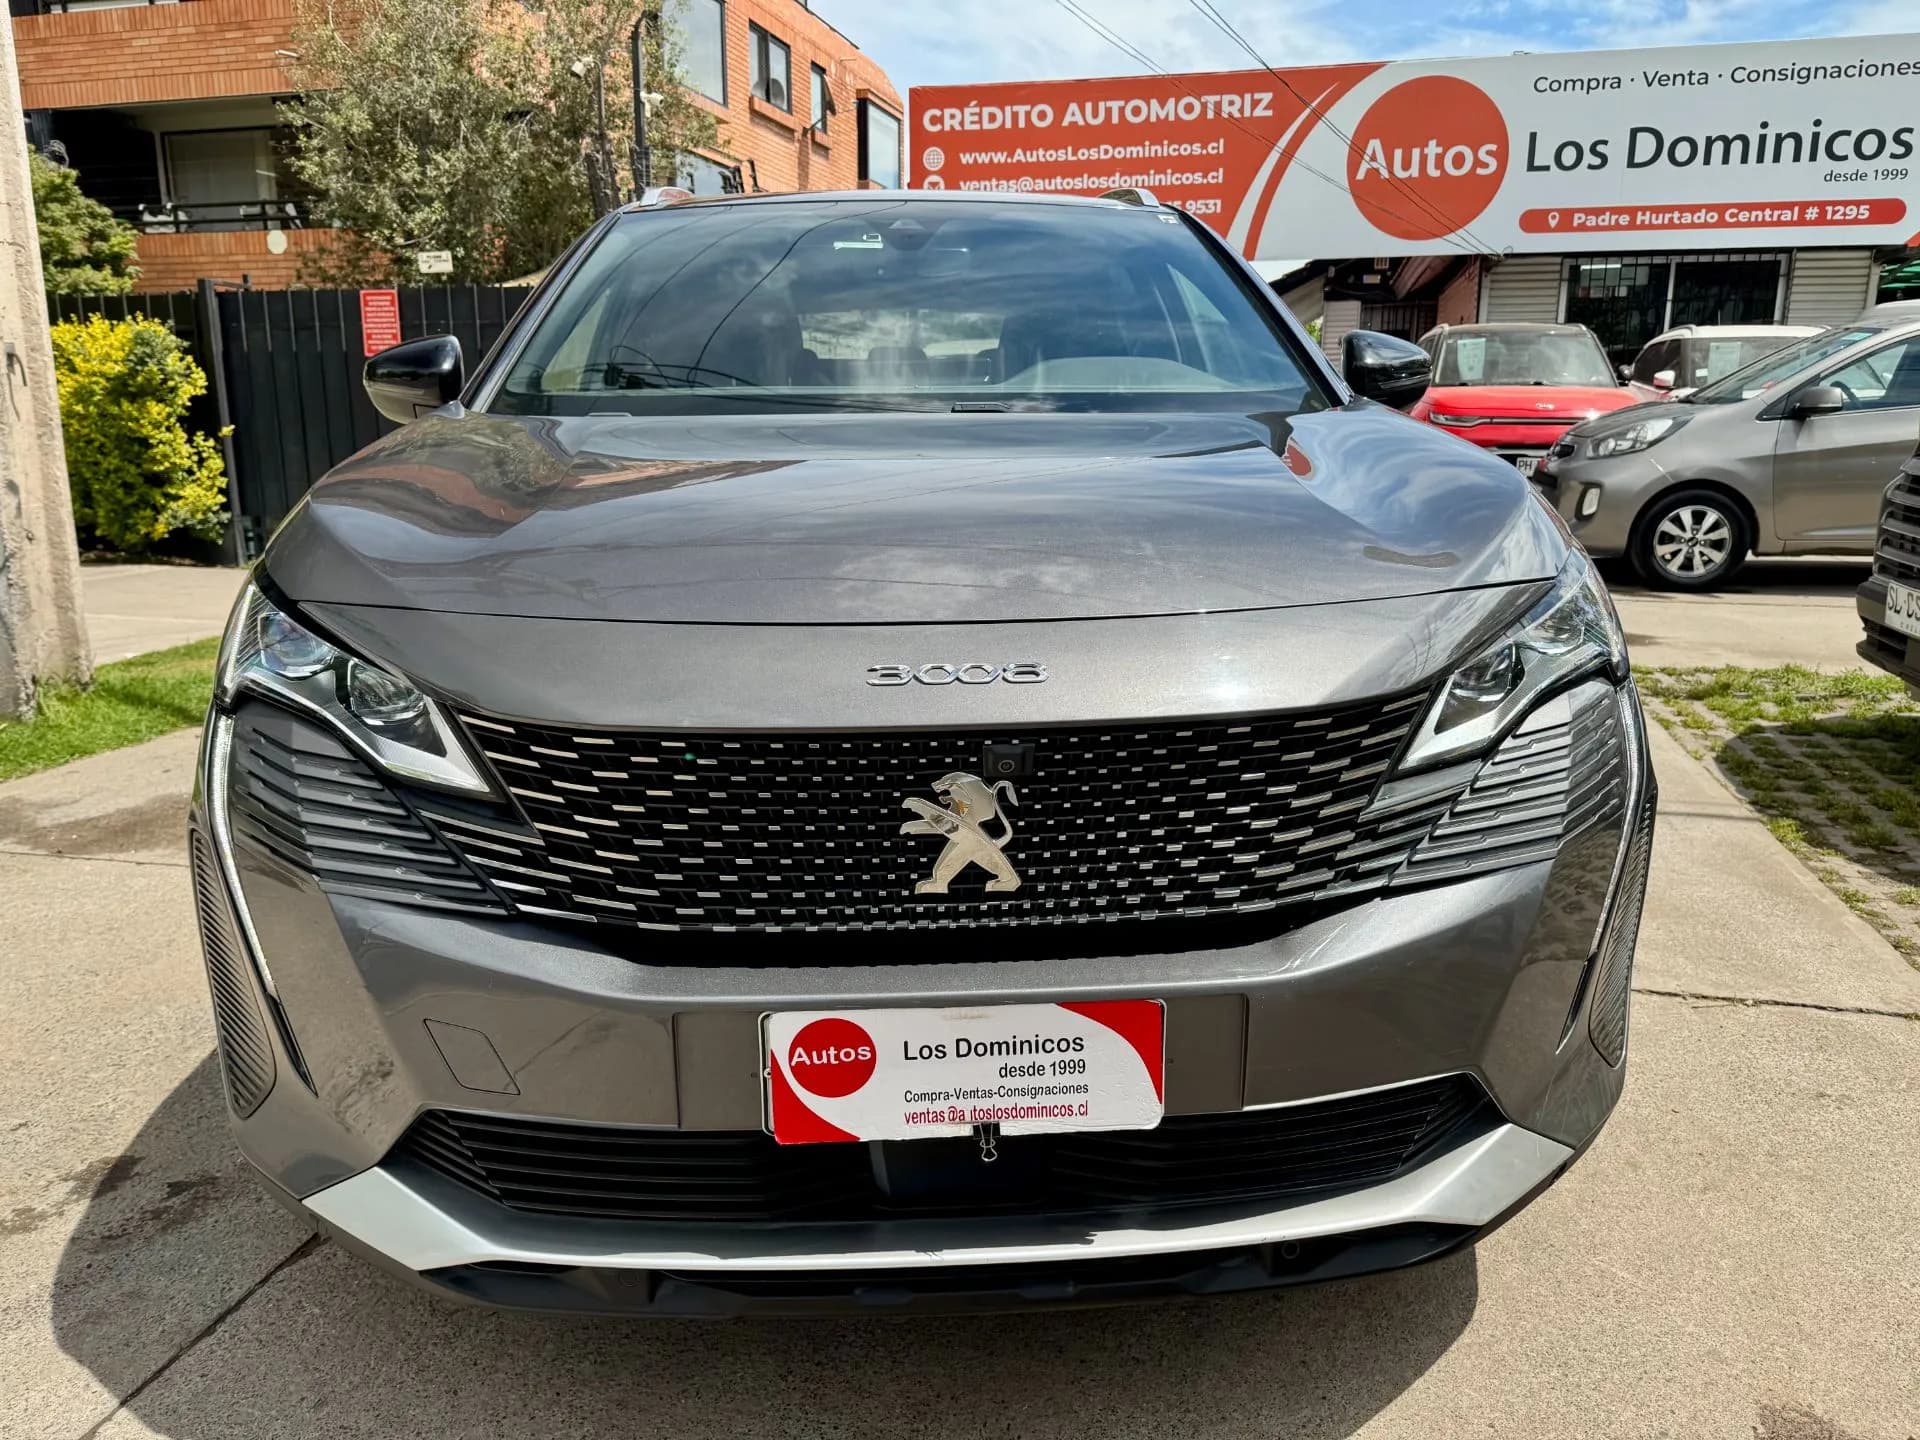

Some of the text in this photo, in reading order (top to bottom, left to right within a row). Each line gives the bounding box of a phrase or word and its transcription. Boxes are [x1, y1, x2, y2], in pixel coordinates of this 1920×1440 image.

[1533, 59, 1920, 95] Compra Venta Consignaciones
[922, 92, 1274, 132] CRÉDITO AUTOMOTRIZ
[959, 139, 1225, 165] www.AutosLosDominicos.cl
[1526, 118, 1915, 172] Los Dominicos
[1355, 138, 1499, 180] Autos
[959, 168, 1224, 193] ventas@autoslosdominicos.cl
[1823, 168, 1909, 183] desde 1999
[1185, 199, 1222, 214] 9531
[1572, 204, 1870, 228] Padre Hurtado Central # 1295
[866, 663, 1049, 686] 3008
[790, 1044, 872, 1067] Autos
[903, 1034, 1085, 1061] Los Dominicos
[998, 1058, 1087, 1079] desde 1999
[904, 1082, 1089, 1105] Compra-Ventas-Consignaciones
